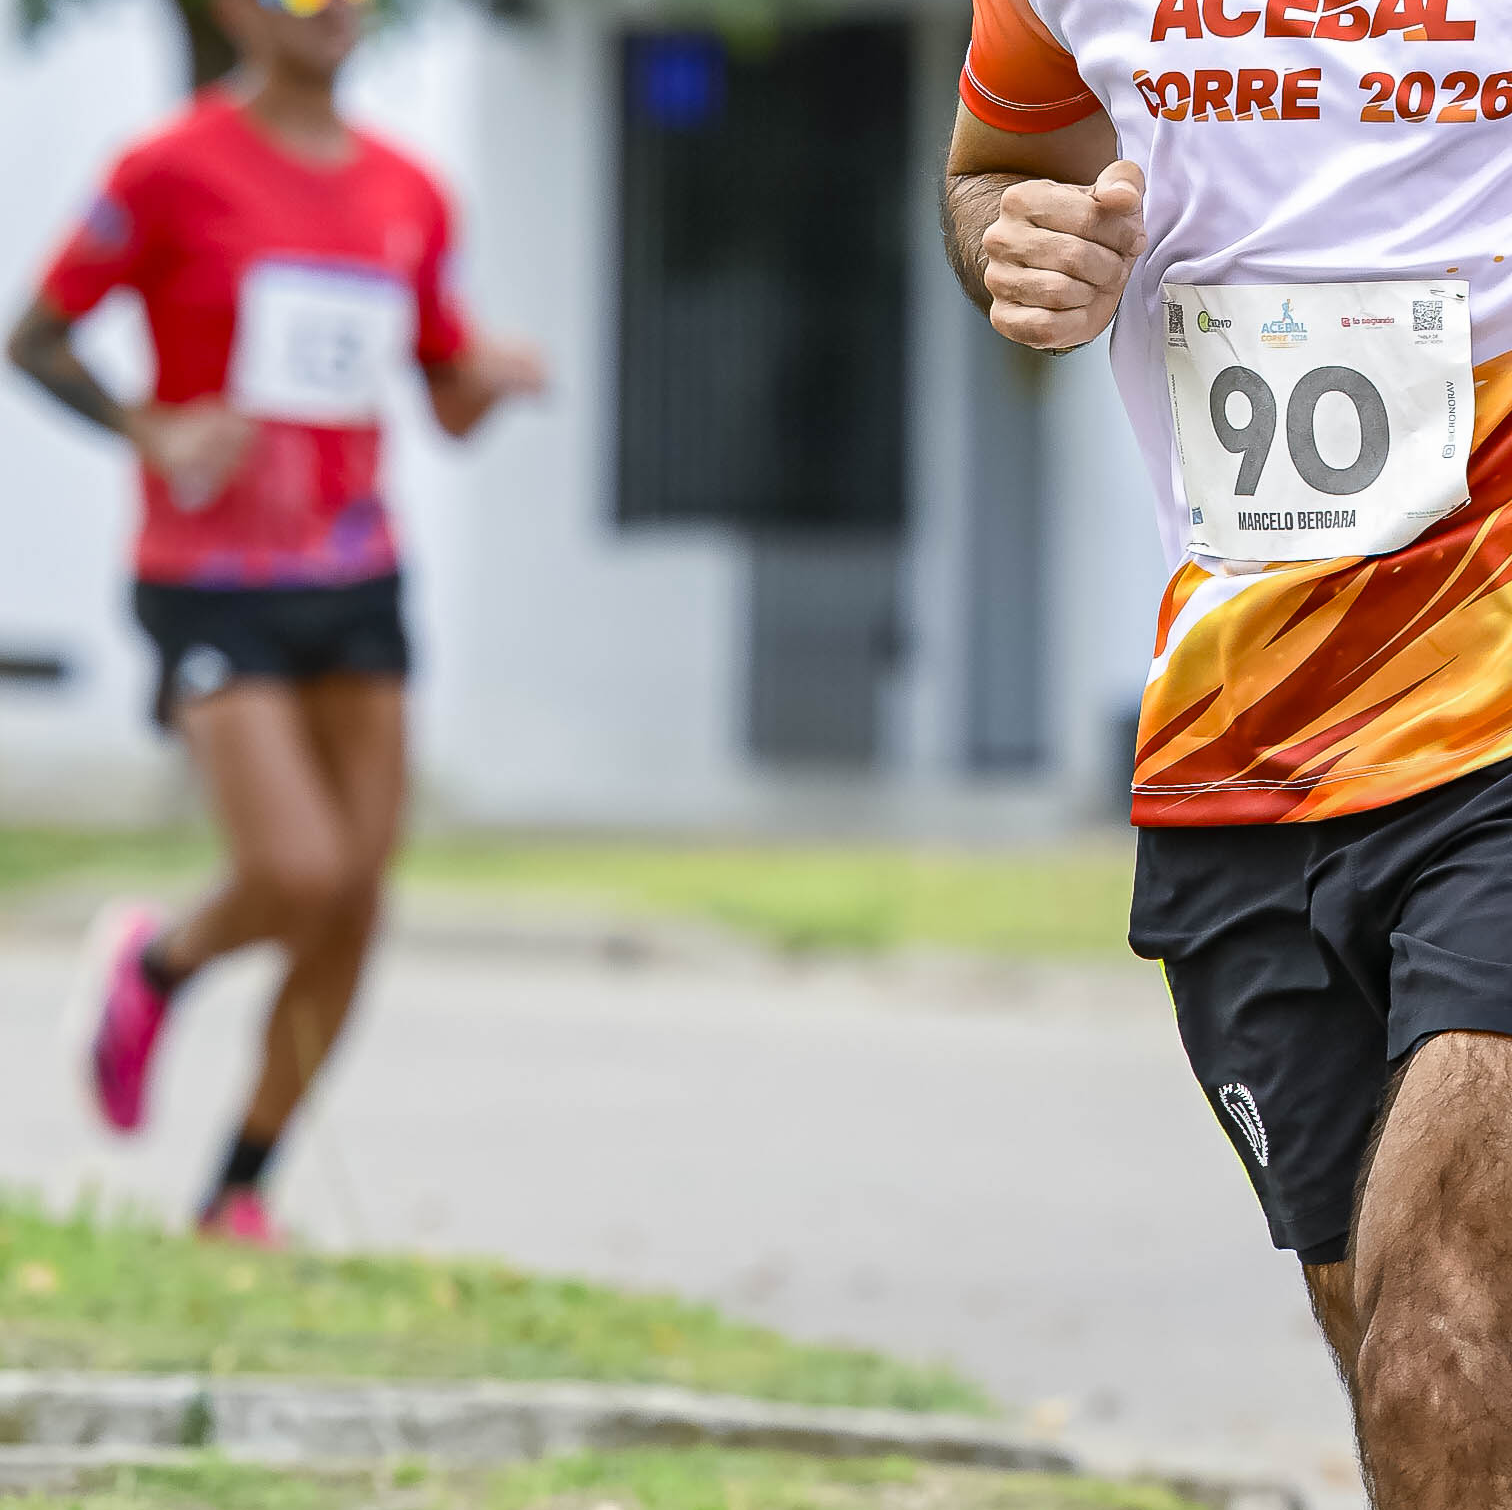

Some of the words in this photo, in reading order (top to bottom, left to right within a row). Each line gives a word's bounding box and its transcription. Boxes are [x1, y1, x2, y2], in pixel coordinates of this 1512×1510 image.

[1132, 68, 1322, 123] CORRE
[1261, 321, 1308, 334] ACEBAL
[1209, 365, 1390, 496] 90
[1238, 511, 1294, 531] MARCELO
[1297, 509, 1356, 530] BERGARA
